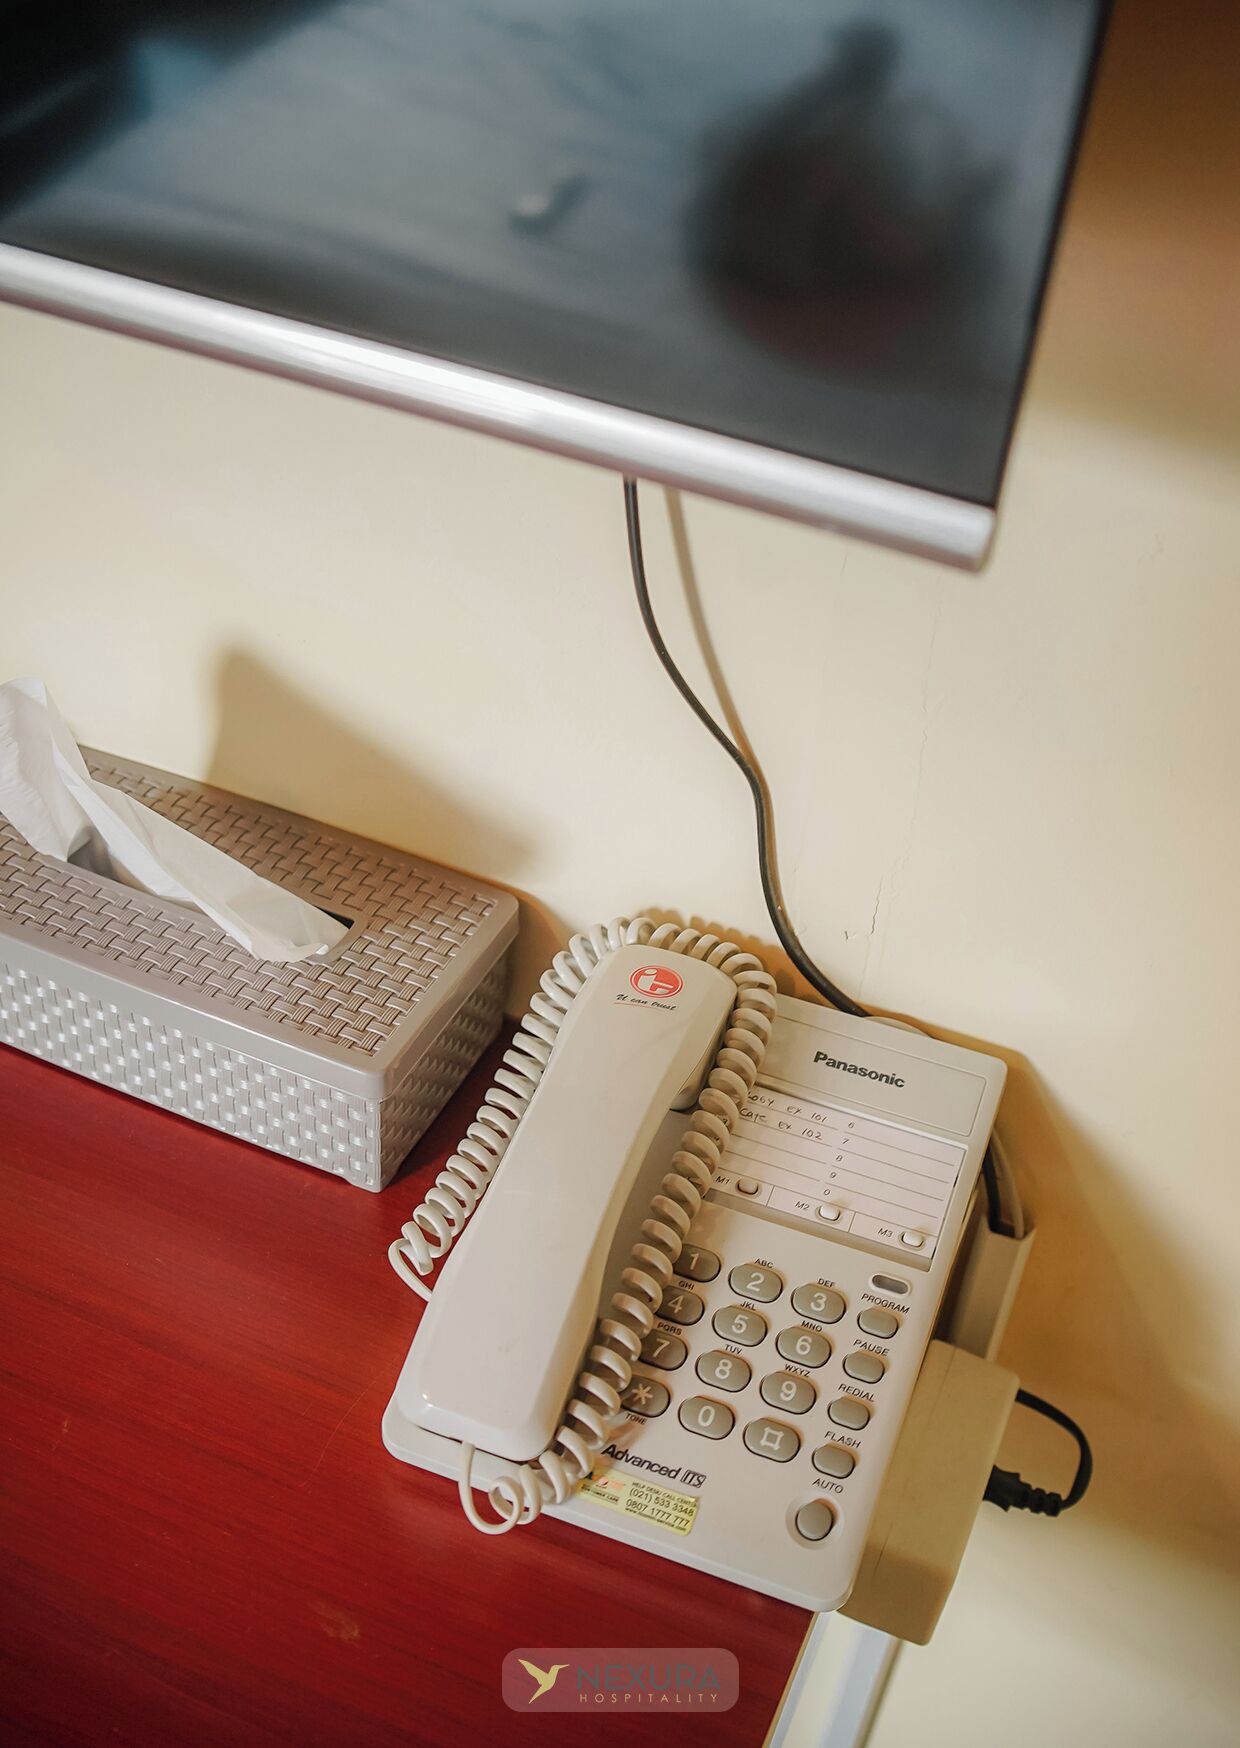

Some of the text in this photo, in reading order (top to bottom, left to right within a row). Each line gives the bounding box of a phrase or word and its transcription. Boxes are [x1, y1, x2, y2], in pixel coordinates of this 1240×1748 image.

[813, 1051, 906, 1088] Panasonic
[810, 1112, 827, 1123] 101
[801, 1128, 823, 1140] 102
[715, 1176, 731, 1185] M1
[823, 1188, 831, 1196] 0
[794, 1200, 811, 1211] M2
[877, 1227, 894, 1238] M3
[689, 1252, 700, 1271] 1
[754, 1258, 774, 1269] ABC
[678, 1280, 695, 1291] GHI
[746, 1272, 765, 1292] 2
[817, 1278, 836, 1289] DEF
[668, 1295, 685, 1314] 4
[740, 1301, 756, 1311] JKL
[810, 1292, 828, 1312] 3
[860, 1292, 910, 1314] PROGRAM
[657, 1321, 683, 1336] PQRS
[731, 1314, 749, 1334] 5
[801, 1320, 823, 1333] MNO
[652, 1338, 670, 1358] 7
[725, 1343, 743, 1355] TUV
[796, 1336, 812, 1355] 6
[853, 1339, 890, 1357] PAUSE
[714, 1359, 733, 1380] 8
[785, 1363, 811, 1378] WXYZ
[780, 1380, 797, 1402] 9
[838, 1383, 875, 1402] REDIAL
[625, 1413, 648, 1425] TONE
[698, 1405, 715, 1427] 0
[824, 1431, 861, 1449] FLASH
[601, 1444, 706, 1488] Advanced ITS
[812, 1478, 844, 1494] AUTO
[629, 1488, 694, 1516] (021) 533 3348
[626, 1499, 648, 1512] 0807
[651, 1507, 672, 1520] 1777
[673, 1515, 690, 1527] 777
